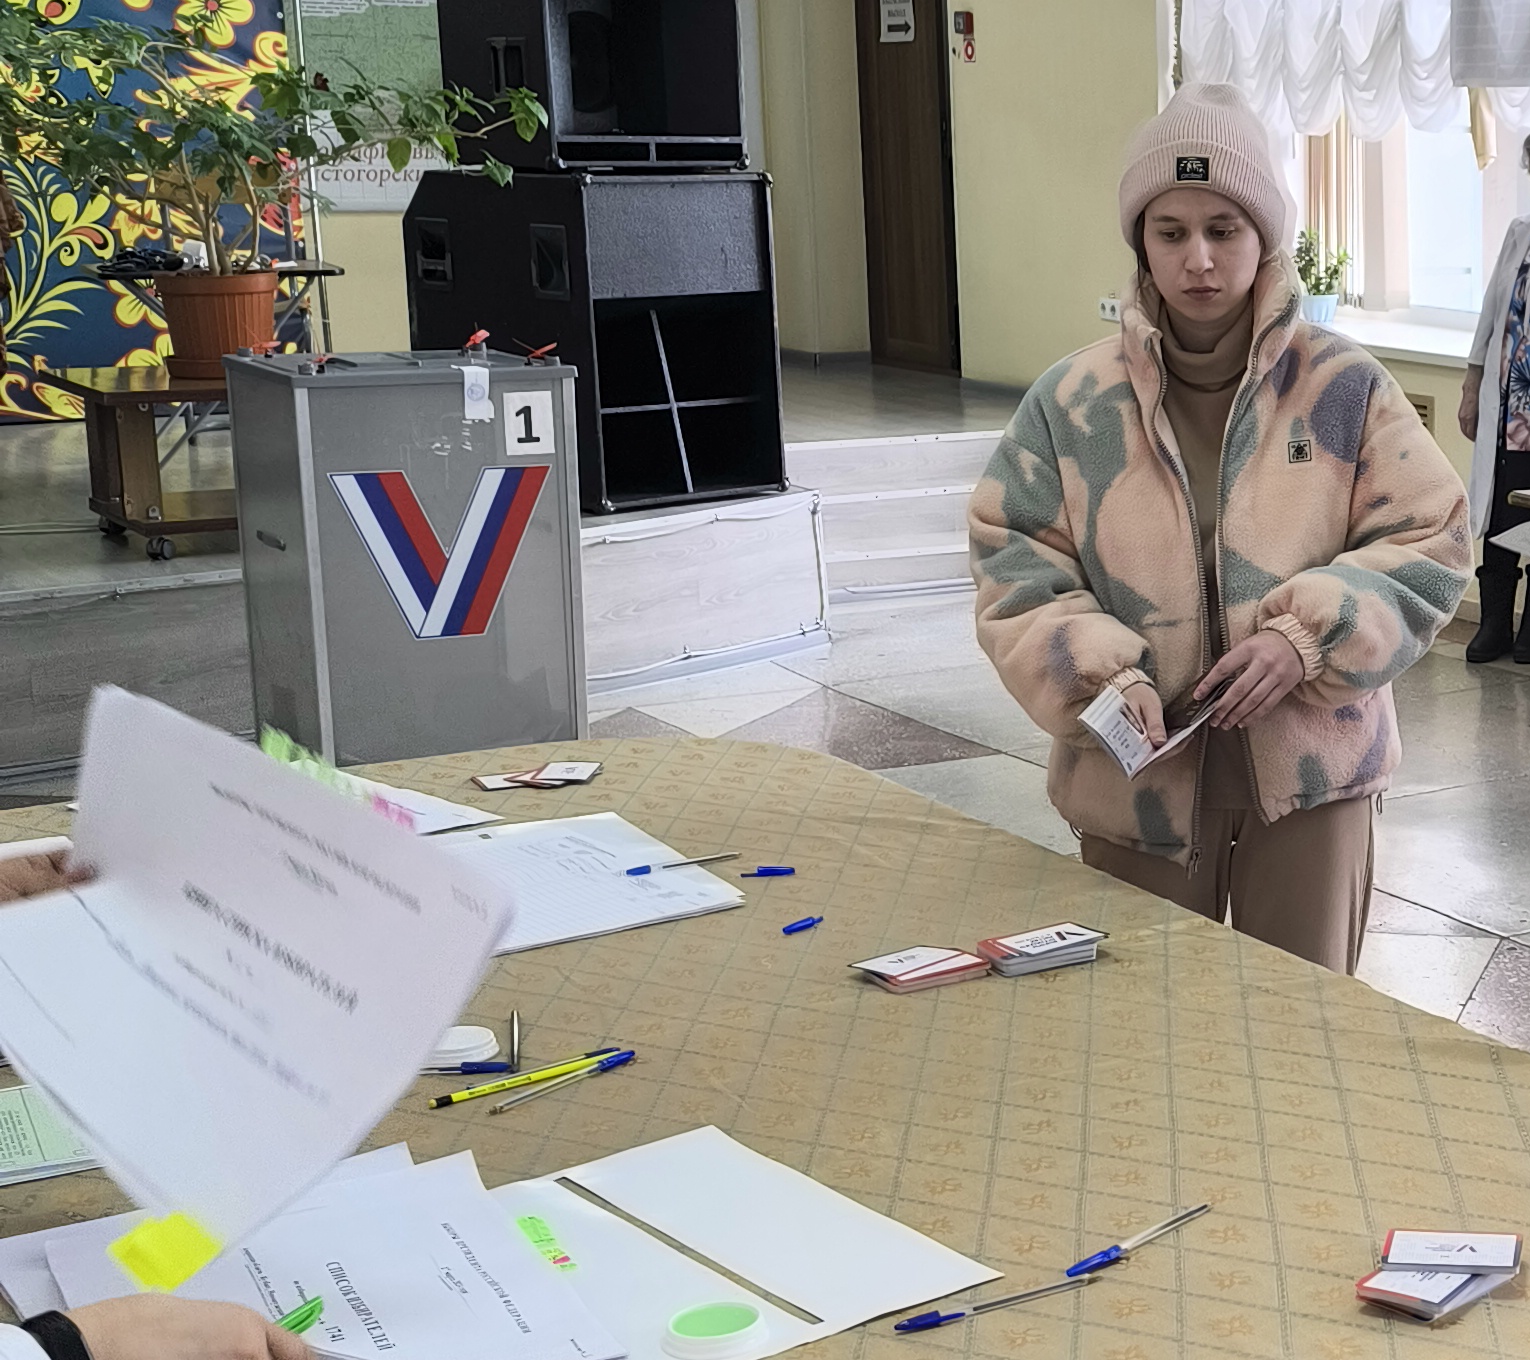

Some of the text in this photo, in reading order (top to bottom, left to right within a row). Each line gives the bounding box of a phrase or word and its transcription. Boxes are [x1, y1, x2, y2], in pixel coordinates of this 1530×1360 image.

[515, 405, 541, 443] 1
[325, 1261, 396, 1351] СПИСОК ИЗБИРАТЕЛЕЙ
